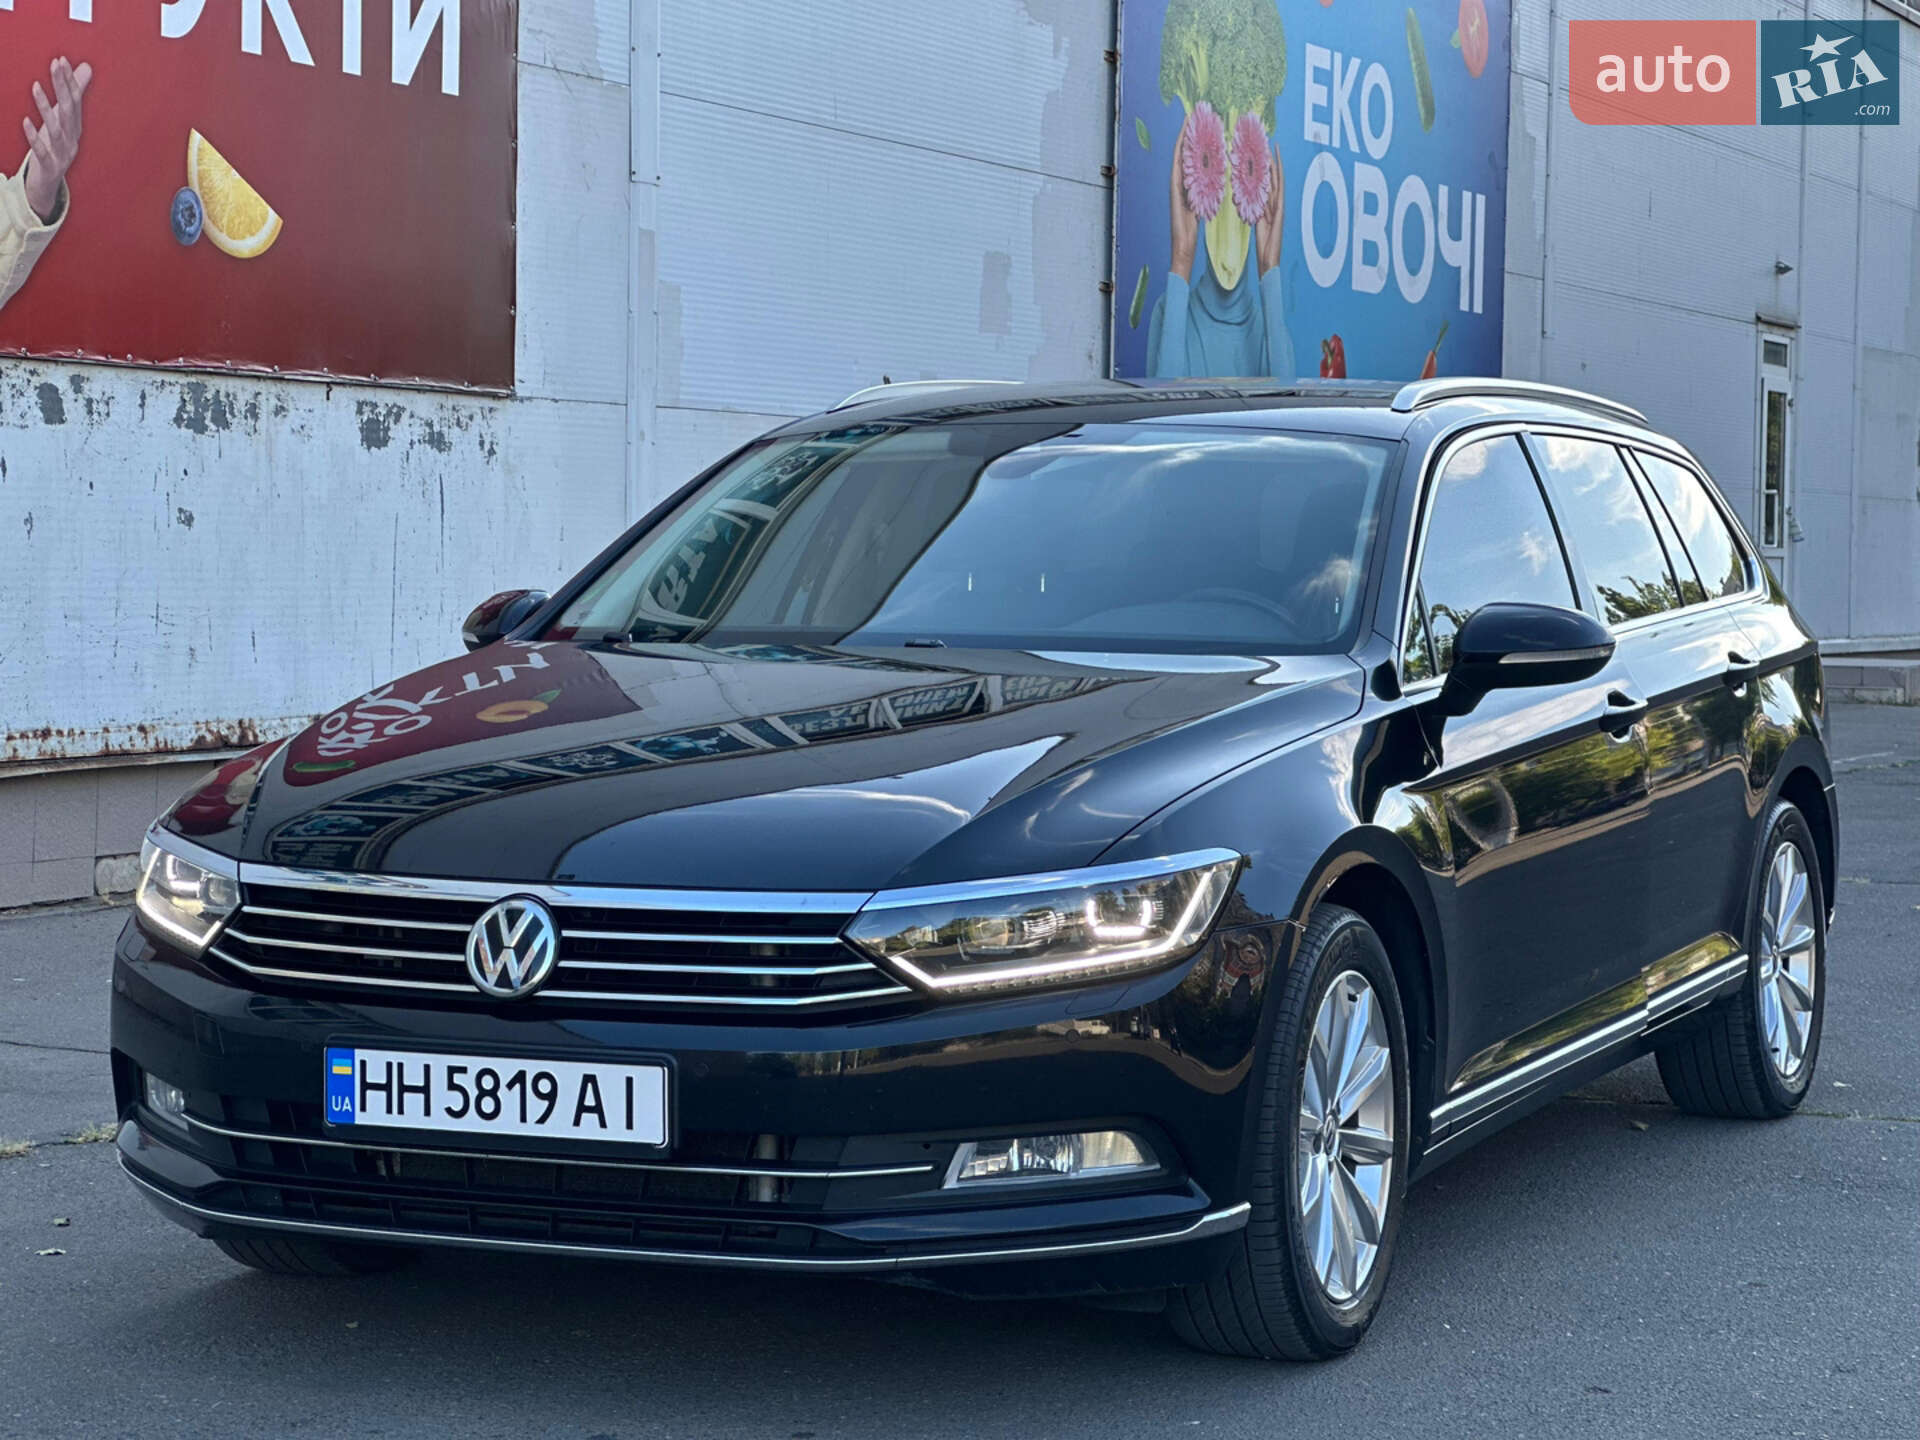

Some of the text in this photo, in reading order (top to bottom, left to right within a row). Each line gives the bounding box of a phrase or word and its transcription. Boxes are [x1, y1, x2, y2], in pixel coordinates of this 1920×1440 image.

[1303, 42, 1394, 160] ЕКО
[1301, 151, 1487, 314] ОВОЧІ
[331, 1095, 352, 1112] UA
